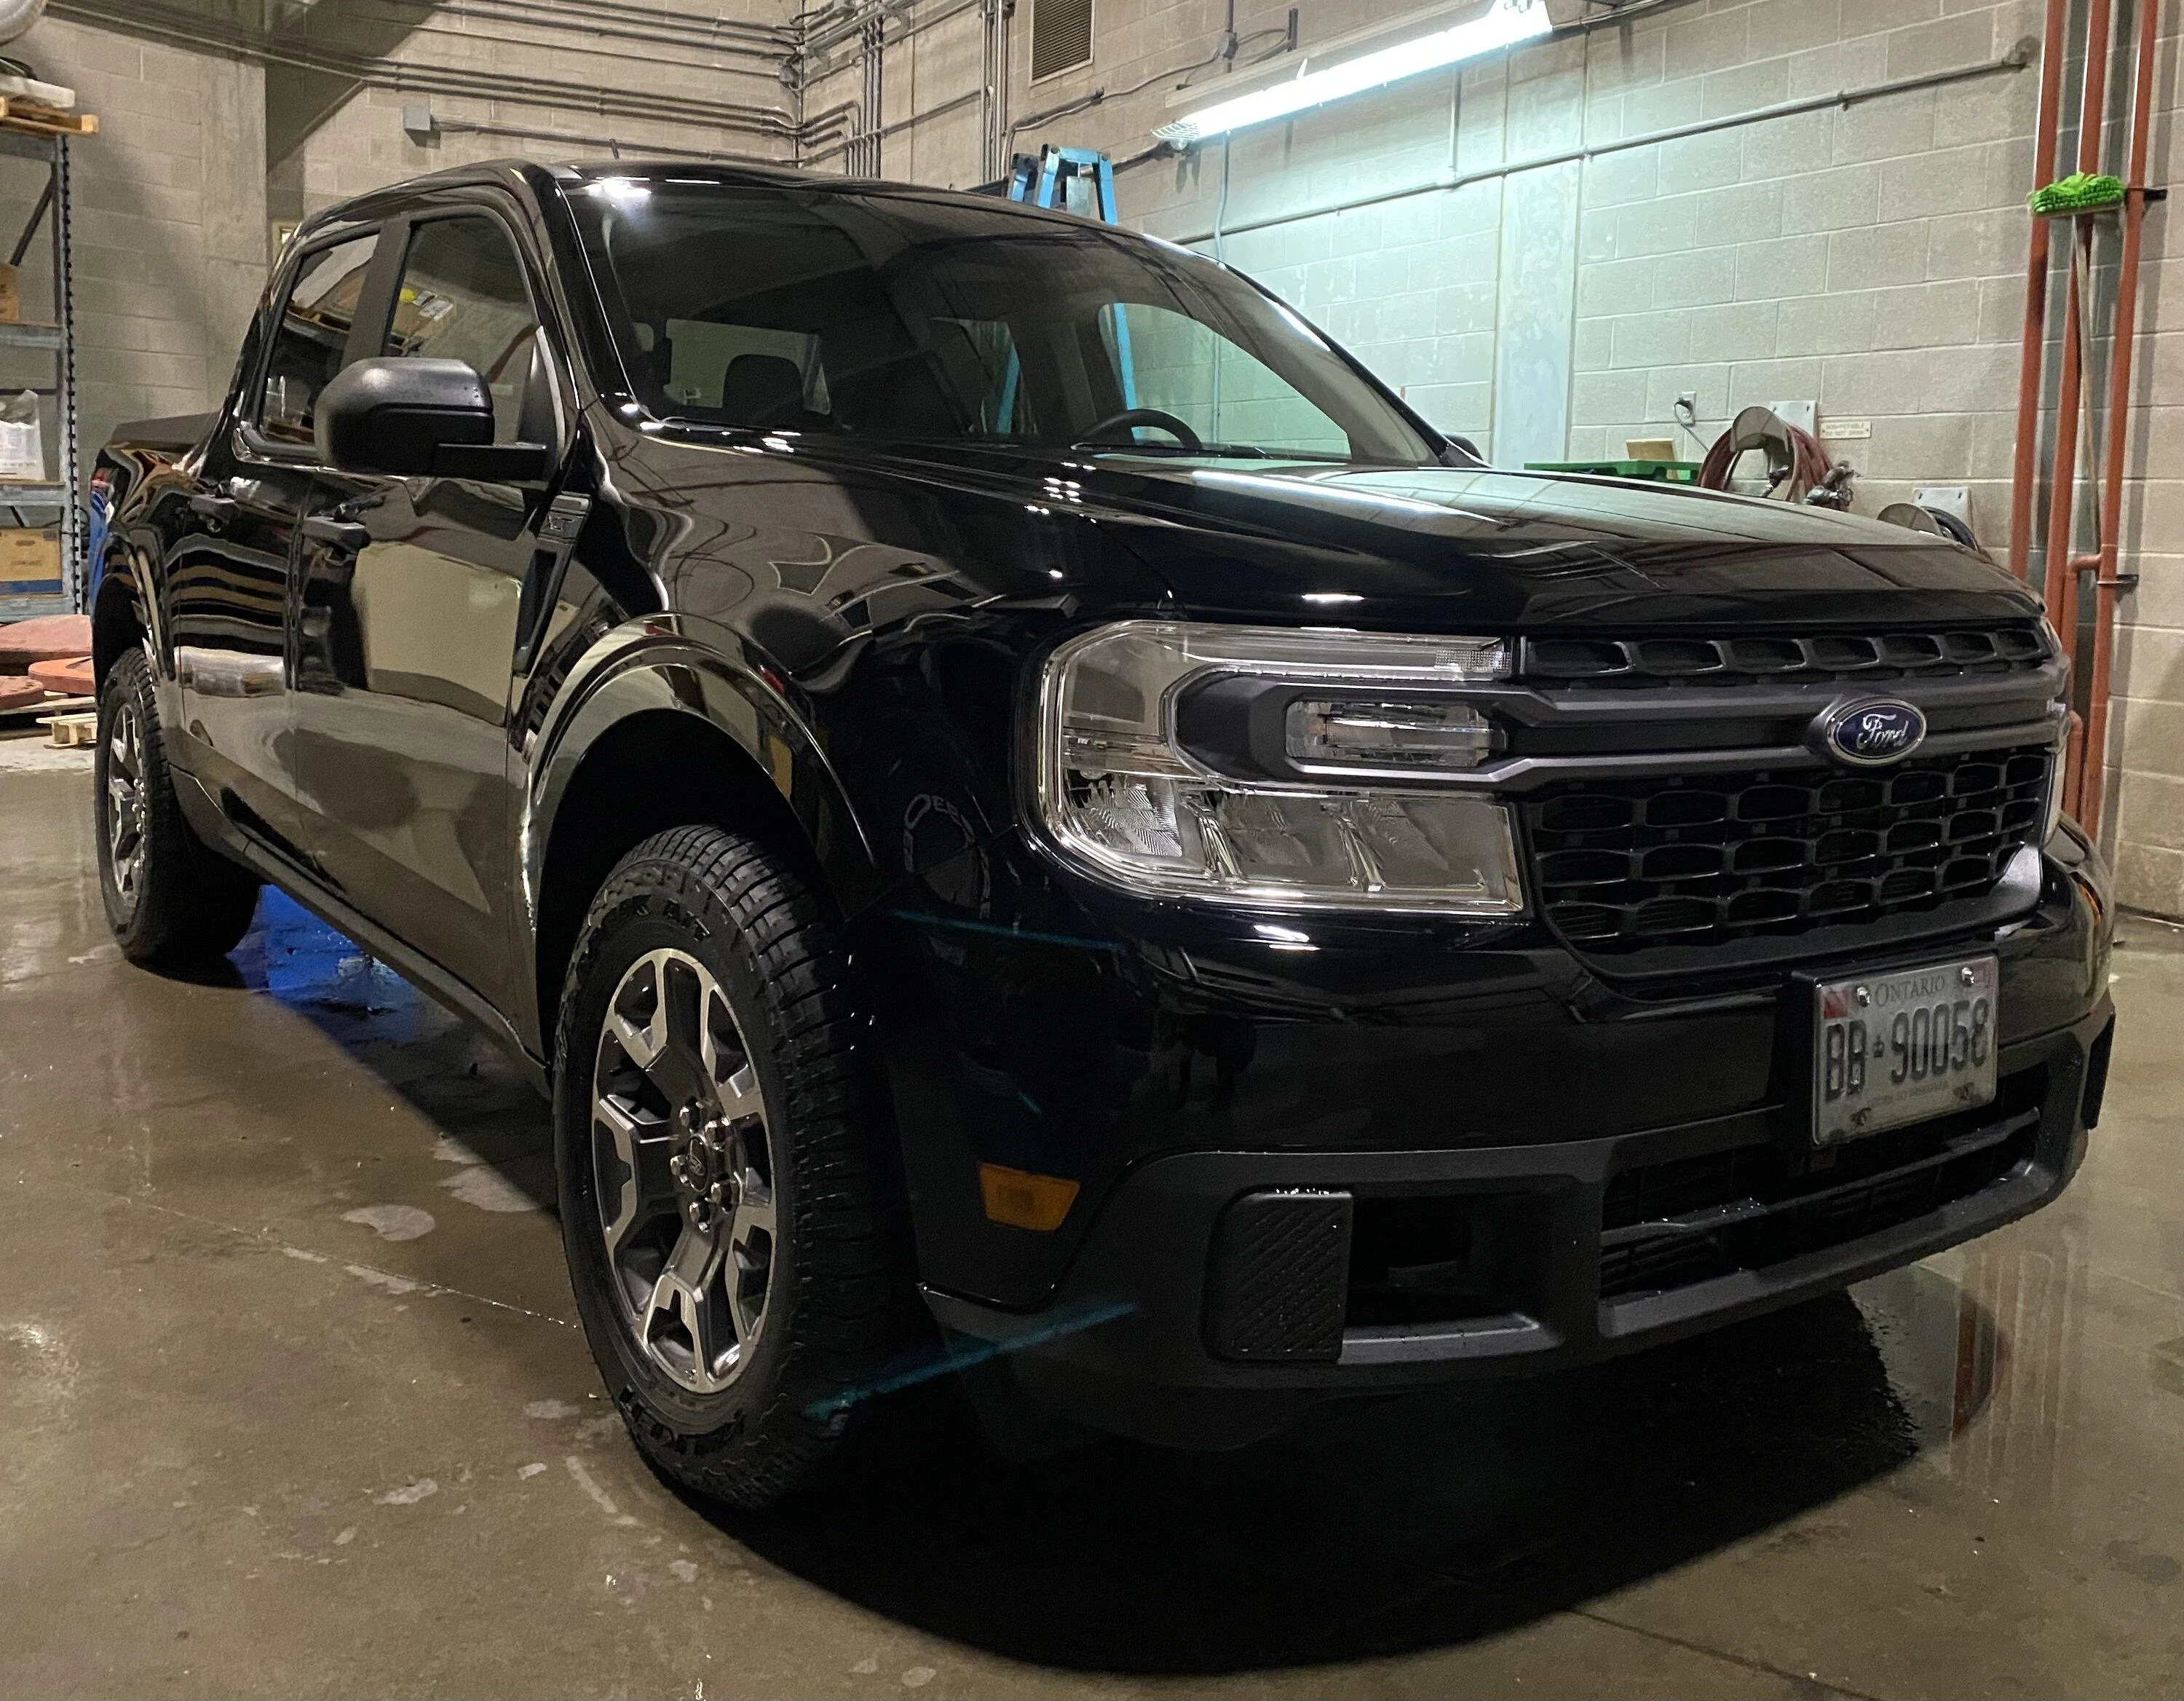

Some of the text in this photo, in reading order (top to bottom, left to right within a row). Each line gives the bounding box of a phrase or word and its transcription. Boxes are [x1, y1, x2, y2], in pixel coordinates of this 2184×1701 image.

[1856, 713, 1910, 751] Ford
[1875, 976, 1945, 1007] ONTARIO
[1891, 997, 1989, 1085] 90058
